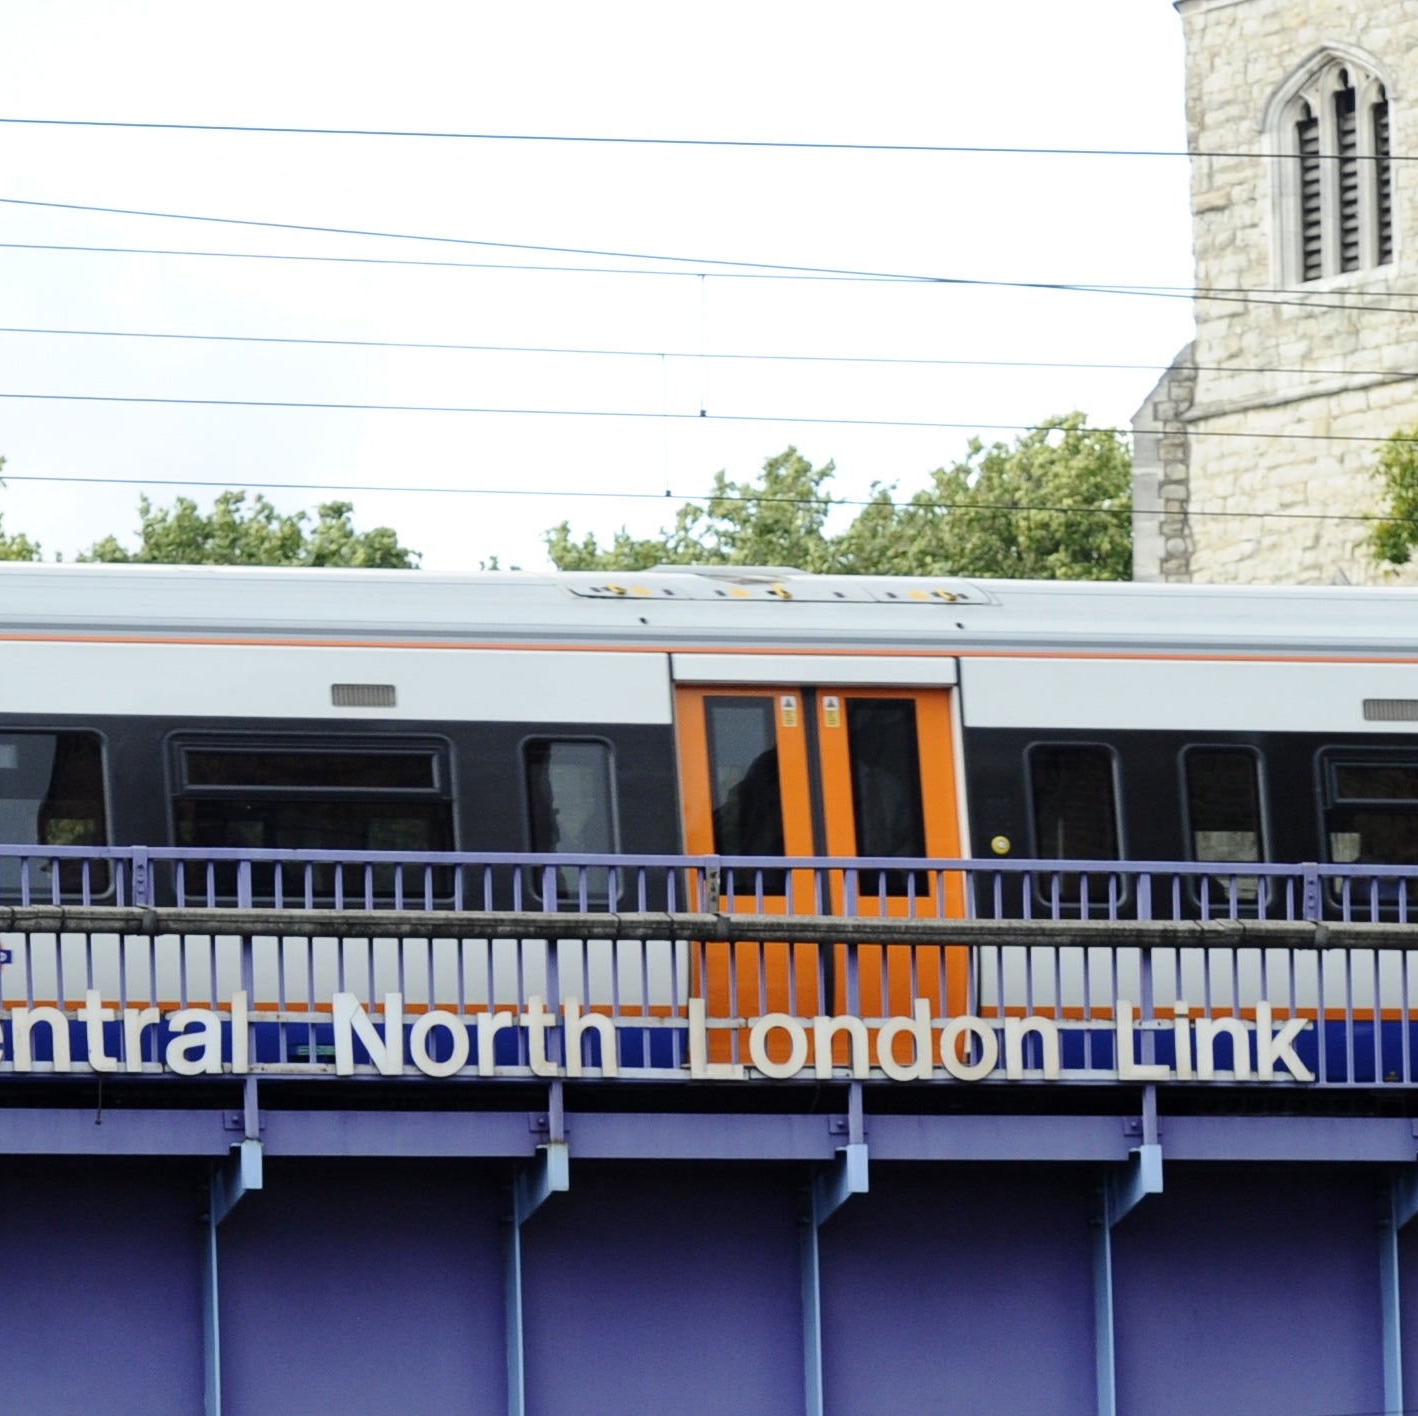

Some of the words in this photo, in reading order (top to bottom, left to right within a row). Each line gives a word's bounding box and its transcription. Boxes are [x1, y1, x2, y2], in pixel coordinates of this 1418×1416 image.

[333, 992, 617, 1079] North
[688, 998, 1058, 1083] London
[1117, 999, 1315, 1084] Link
